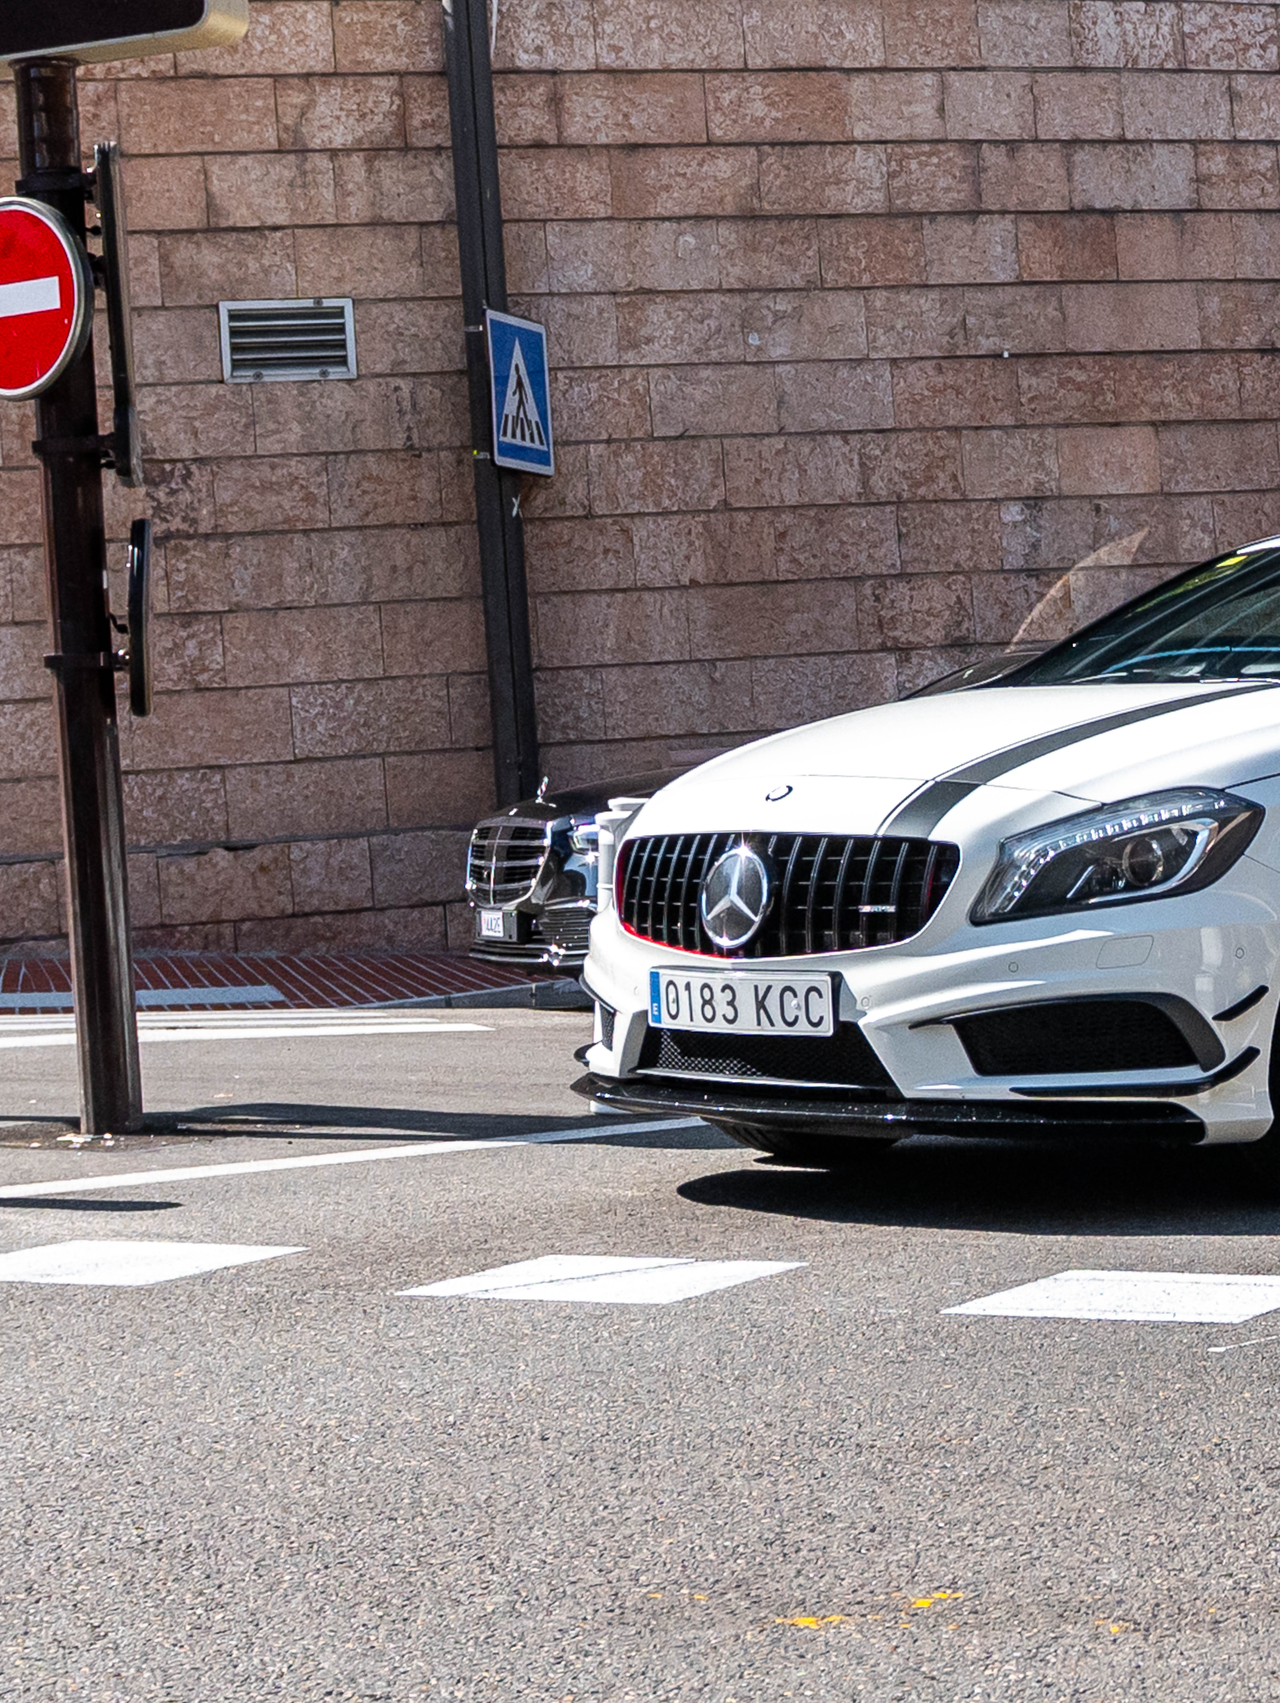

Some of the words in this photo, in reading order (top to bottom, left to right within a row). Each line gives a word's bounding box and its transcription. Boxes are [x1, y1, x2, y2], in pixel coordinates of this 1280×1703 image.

[652, 1003, 659, 1016] E
[665, 979, 739, 1025] 0183
[753, 984, 825, 1028] KCC
